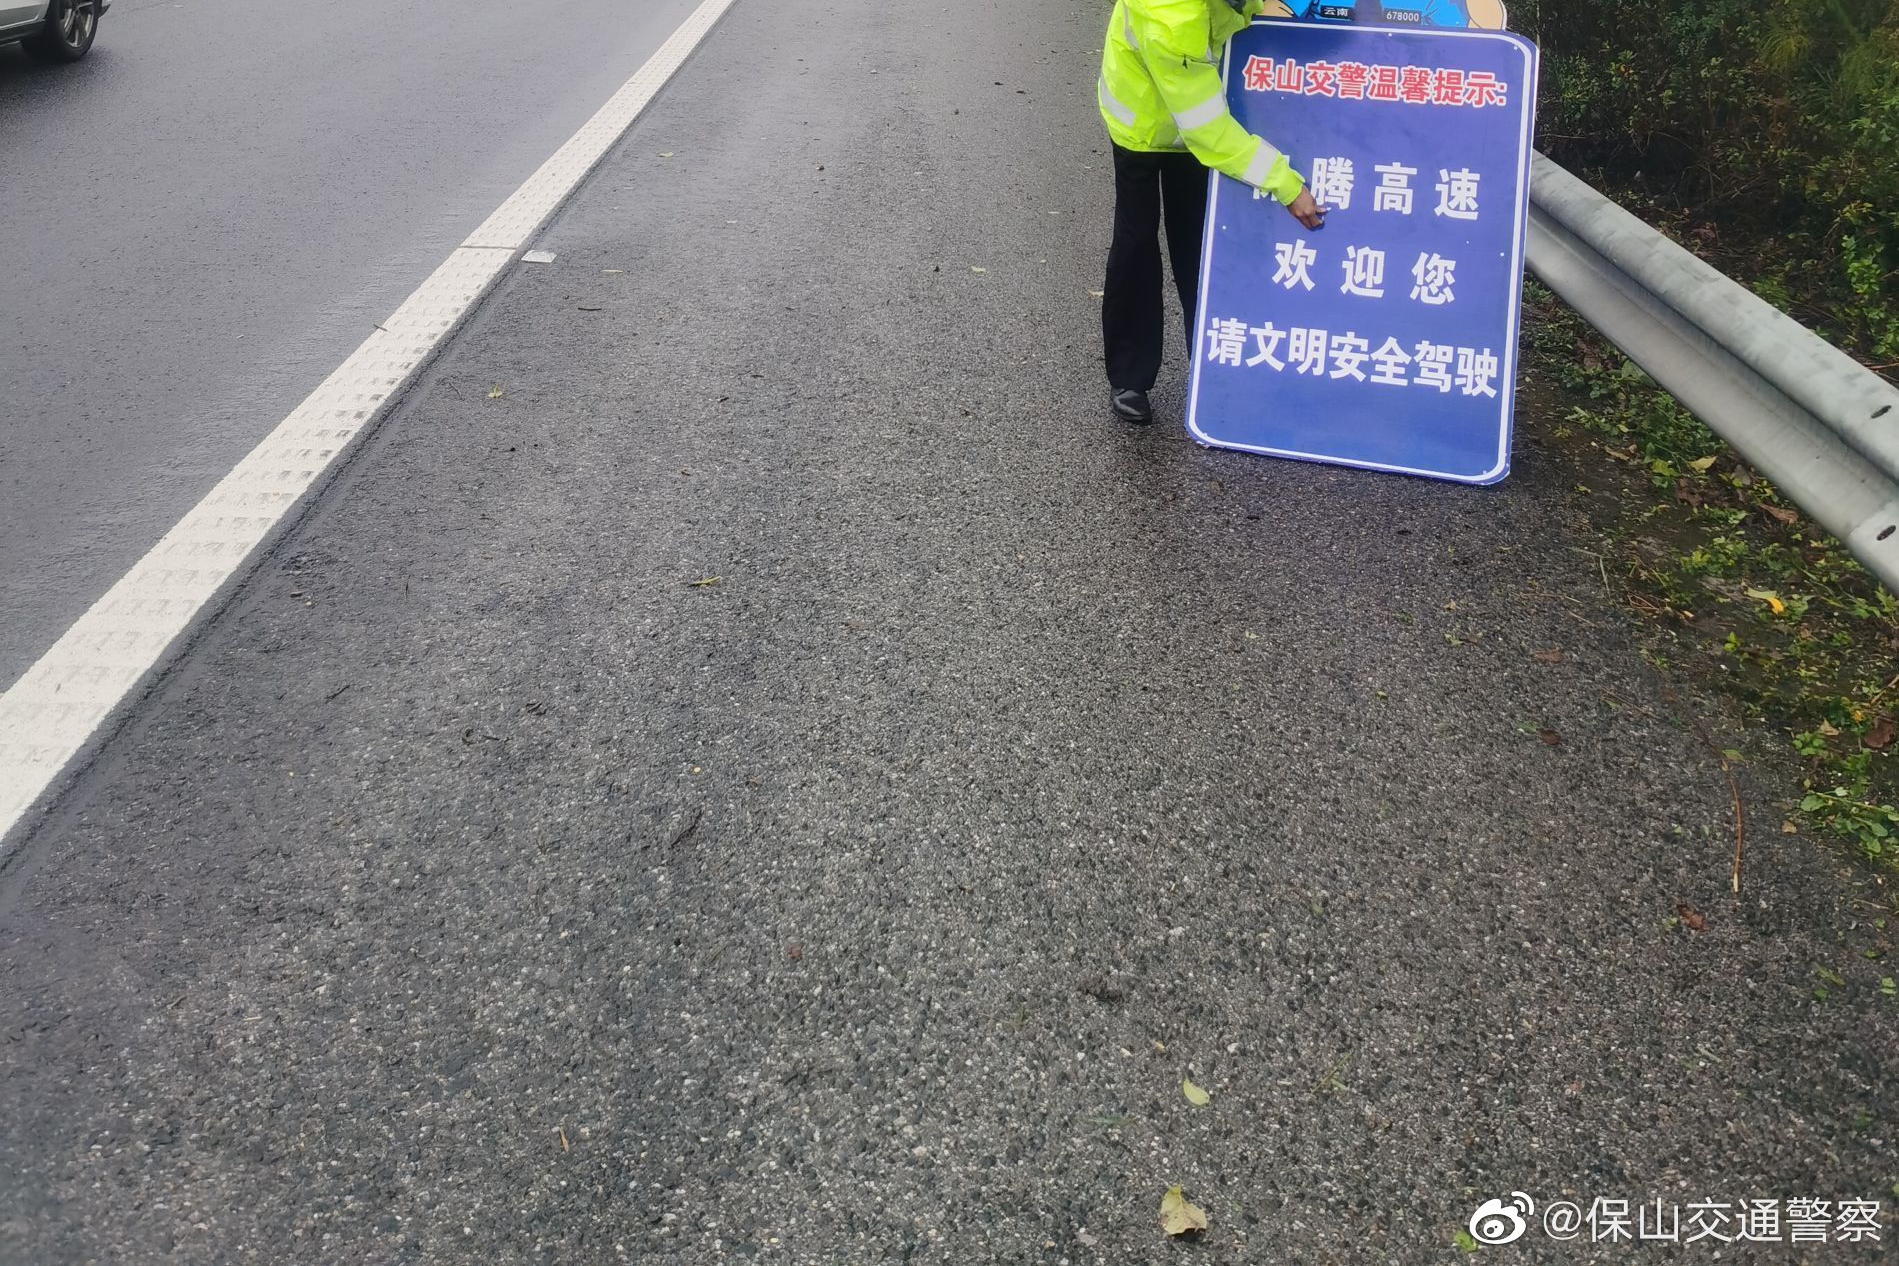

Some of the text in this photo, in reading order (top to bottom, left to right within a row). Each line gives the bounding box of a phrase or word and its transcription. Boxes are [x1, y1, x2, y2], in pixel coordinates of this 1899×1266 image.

[1324, 7, 1349, 17] 云南
[1386, 11, 1420, 22] 678000
[1272, 239, 1456, 305] 欢迎您
[1207, 317, 1498, 399] 请文明安全驾驶
